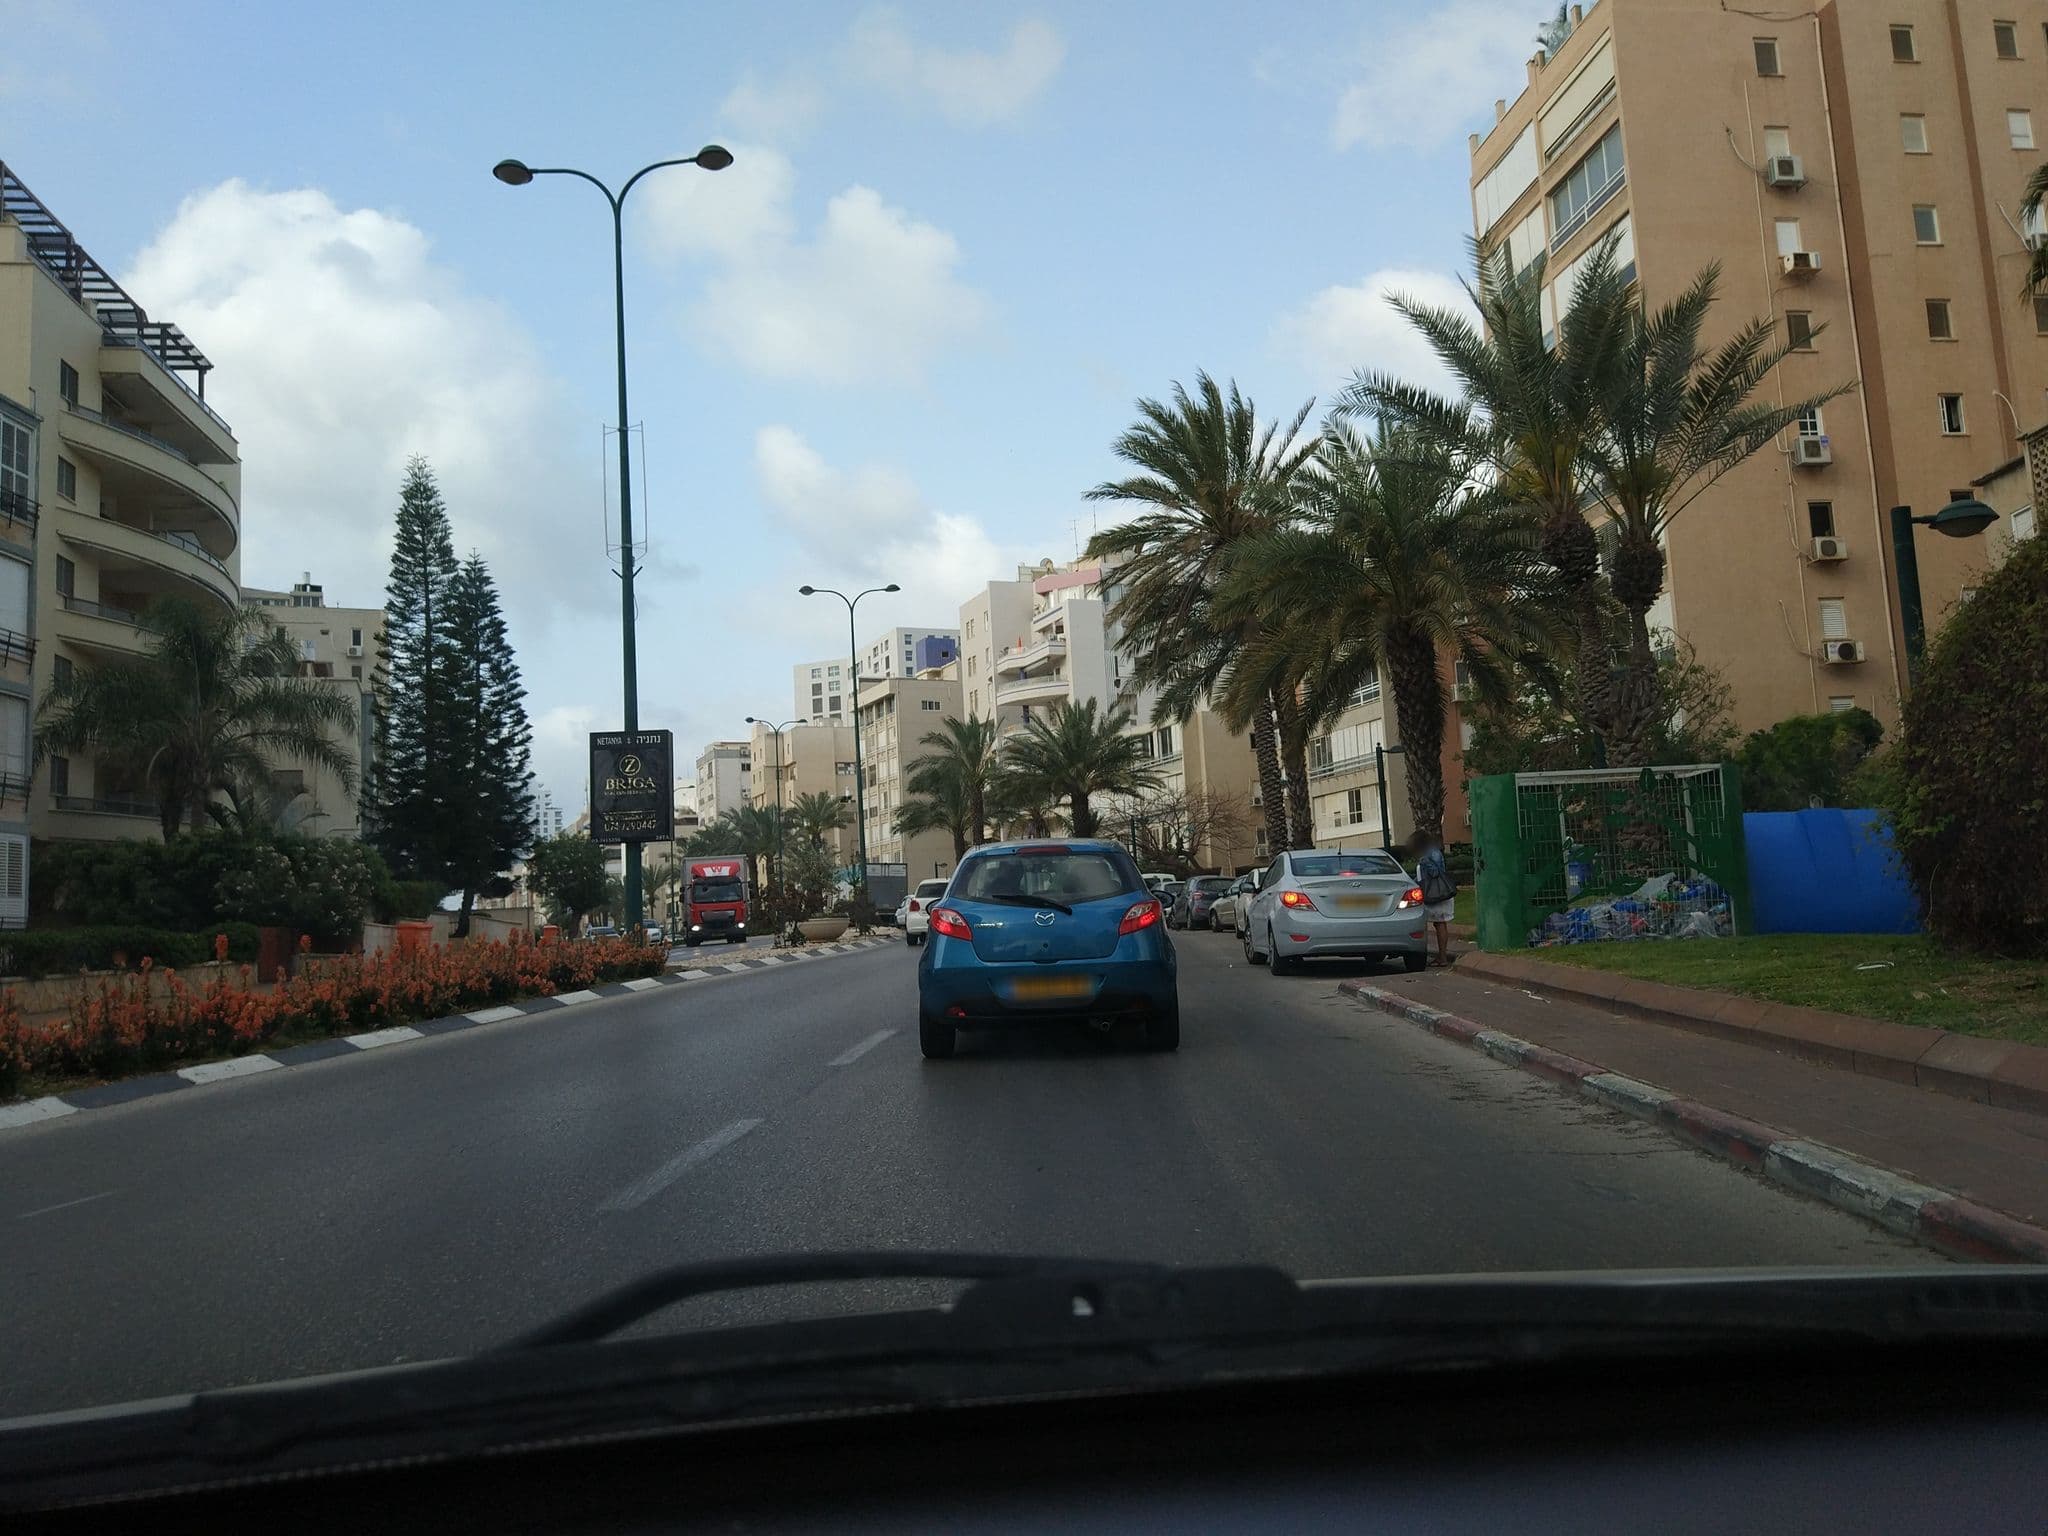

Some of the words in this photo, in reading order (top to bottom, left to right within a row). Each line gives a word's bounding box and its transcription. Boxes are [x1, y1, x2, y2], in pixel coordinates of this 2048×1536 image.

[597, 737, 622, 746] NETANYA
[636, 736, 661, 744] נתניה
[606, 777, 656, 789] BRIGA
